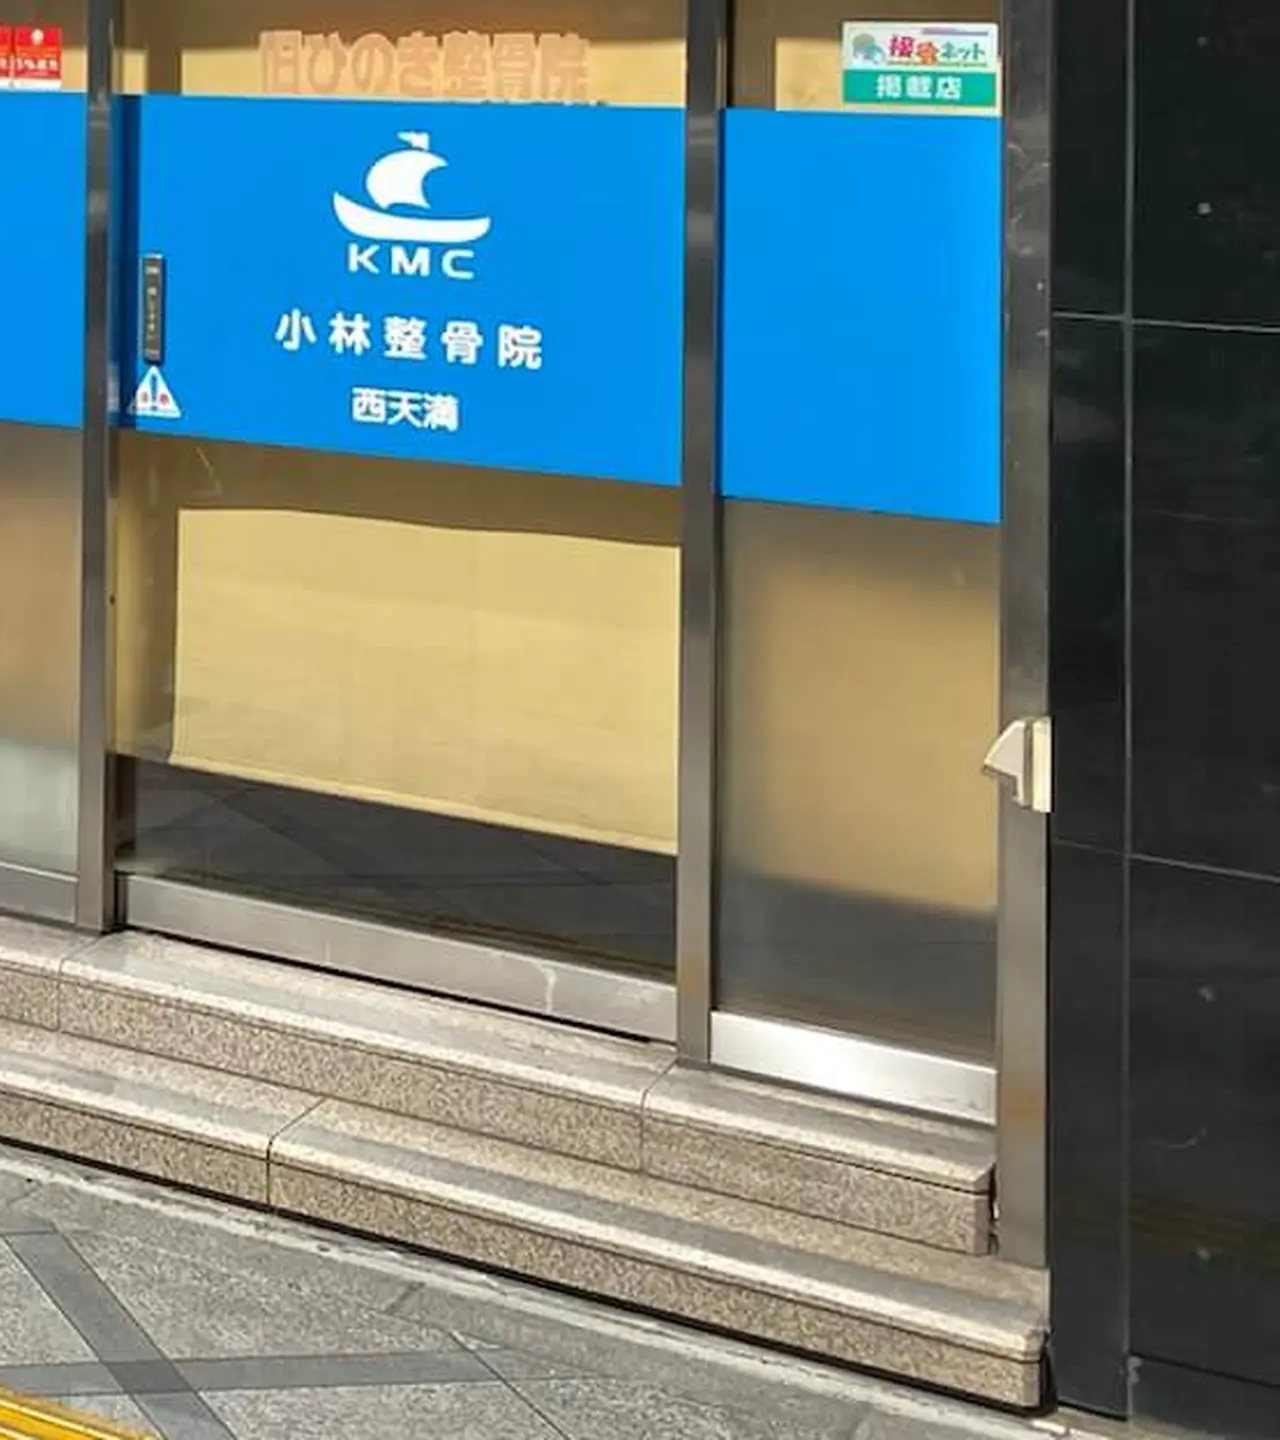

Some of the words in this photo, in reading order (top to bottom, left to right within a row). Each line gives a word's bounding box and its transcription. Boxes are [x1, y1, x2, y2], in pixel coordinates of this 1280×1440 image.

[347, 242, 476, 280] KMC
[275, 307, 543, 371] 小林整骨院
[351, 386, 460, 432] 西天満
